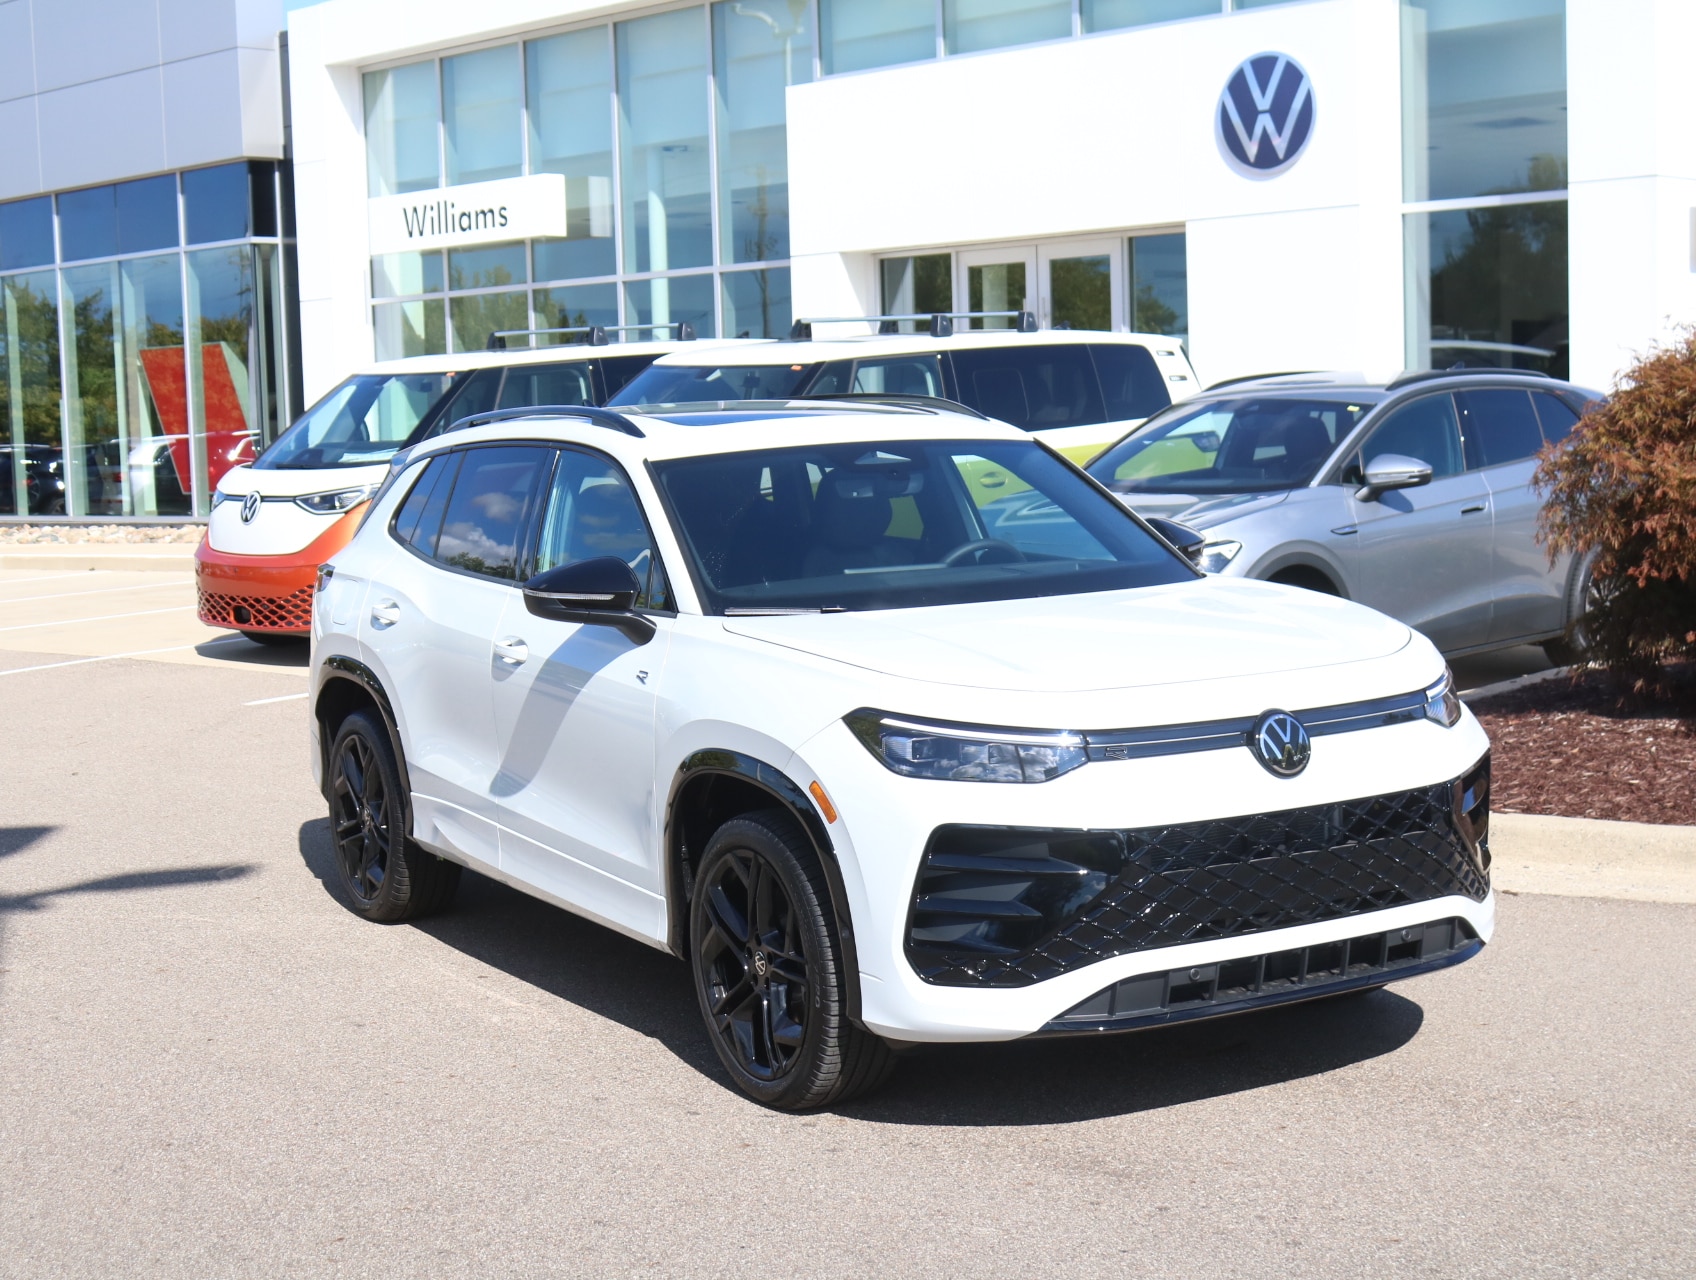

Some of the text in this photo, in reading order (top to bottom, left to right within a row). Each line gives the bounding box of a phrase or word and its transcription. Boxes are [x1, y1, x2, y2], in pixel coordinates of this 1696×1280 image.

[1217, 51, 1316, 170] VW
[402, 199, 508, 238] Williams
[241, 491, 260, 524] VW
[1259, 713, 1310, 774] VW
